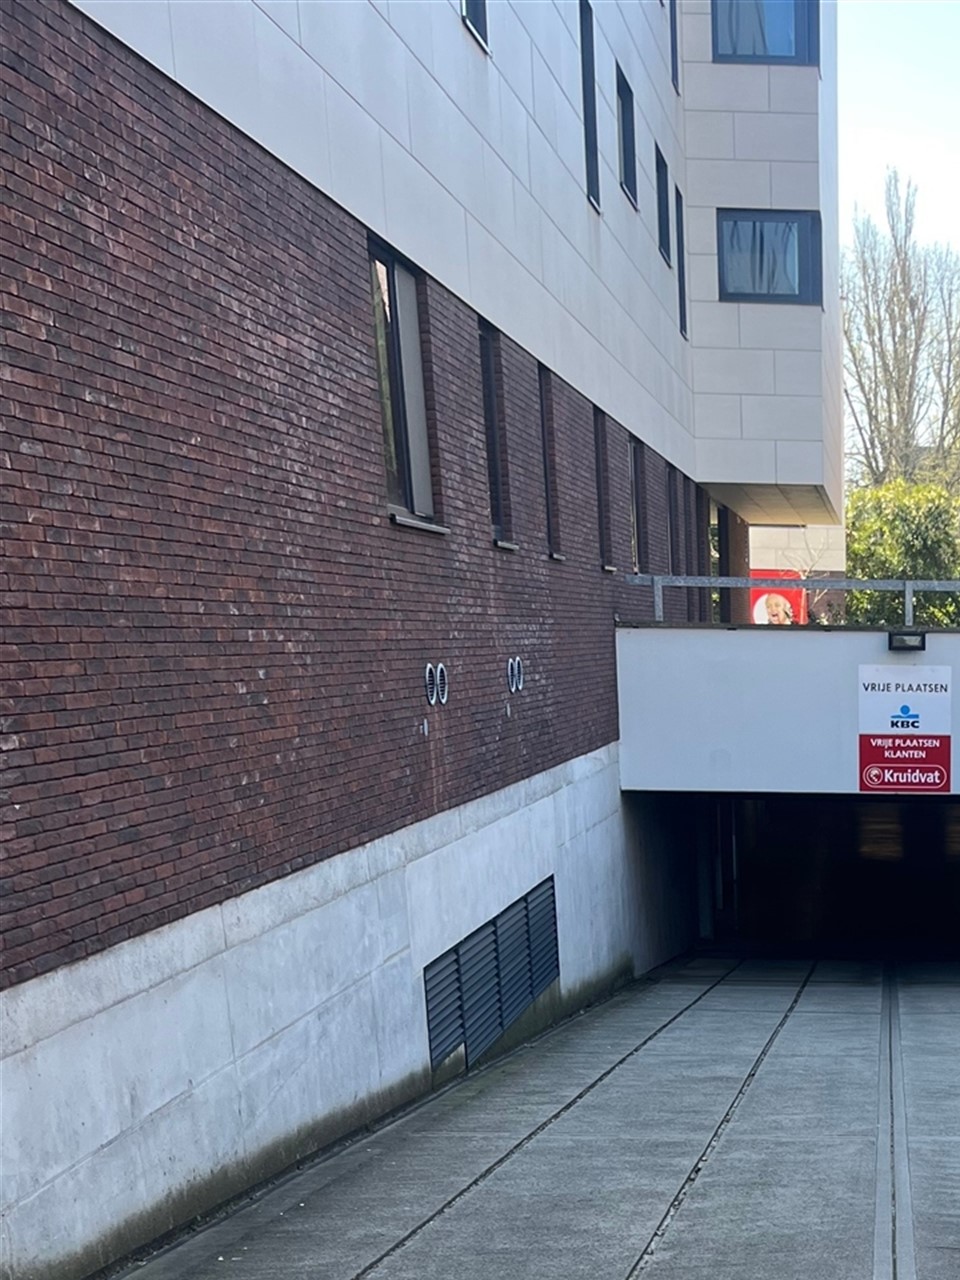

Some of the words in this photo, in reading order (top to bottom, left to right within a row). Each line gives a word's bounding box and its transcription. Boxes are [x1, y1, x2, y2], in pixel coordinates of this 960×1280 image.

[862, 682, 892, 692] VRIJE
[895, 683, 948, 693] PLAATSEN
[890, 720, 920, 729] KBC
[870, 738, 893, 748] VRIJE
[895, 739, 940, 748] PLAATSEN
[884, 750, 926, 758] KLANTEN
[884, 769, 941, 783] Kruidvat
